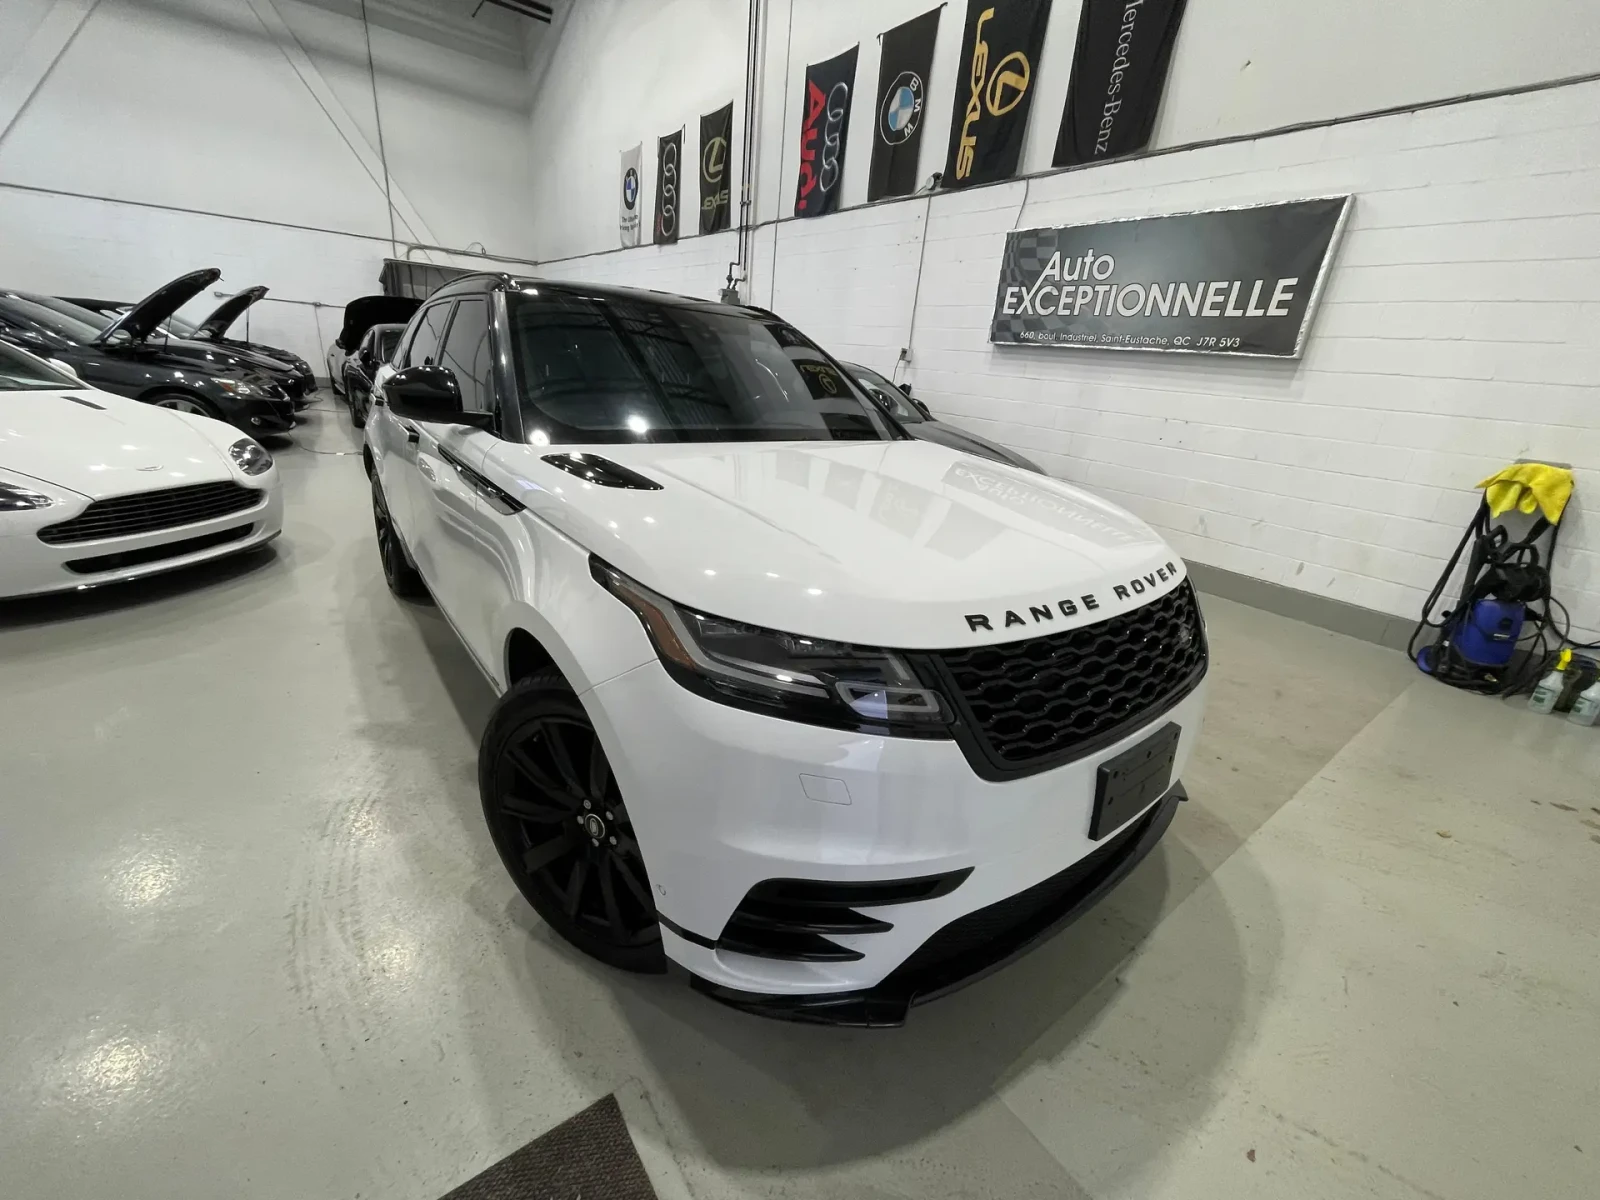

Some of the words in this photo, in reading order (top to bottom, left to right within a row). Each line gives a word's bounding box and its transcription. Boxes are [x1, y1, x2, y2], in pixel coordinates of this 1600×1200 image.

[956, 7, 994, 180] LEXUS
[1039, 248, 1116, 282] Auto
[1002, 277, 1299, 317] EXCEPTIONNELLE
[1173, 336, 1191, 347] QC
[1196, 336, 1217, 348] J7R
[1219, 337, 1240, 348] 5V3
[964, 593, 1100, 633] RANGE
[1112, 561, 1178, 601] ROVER
